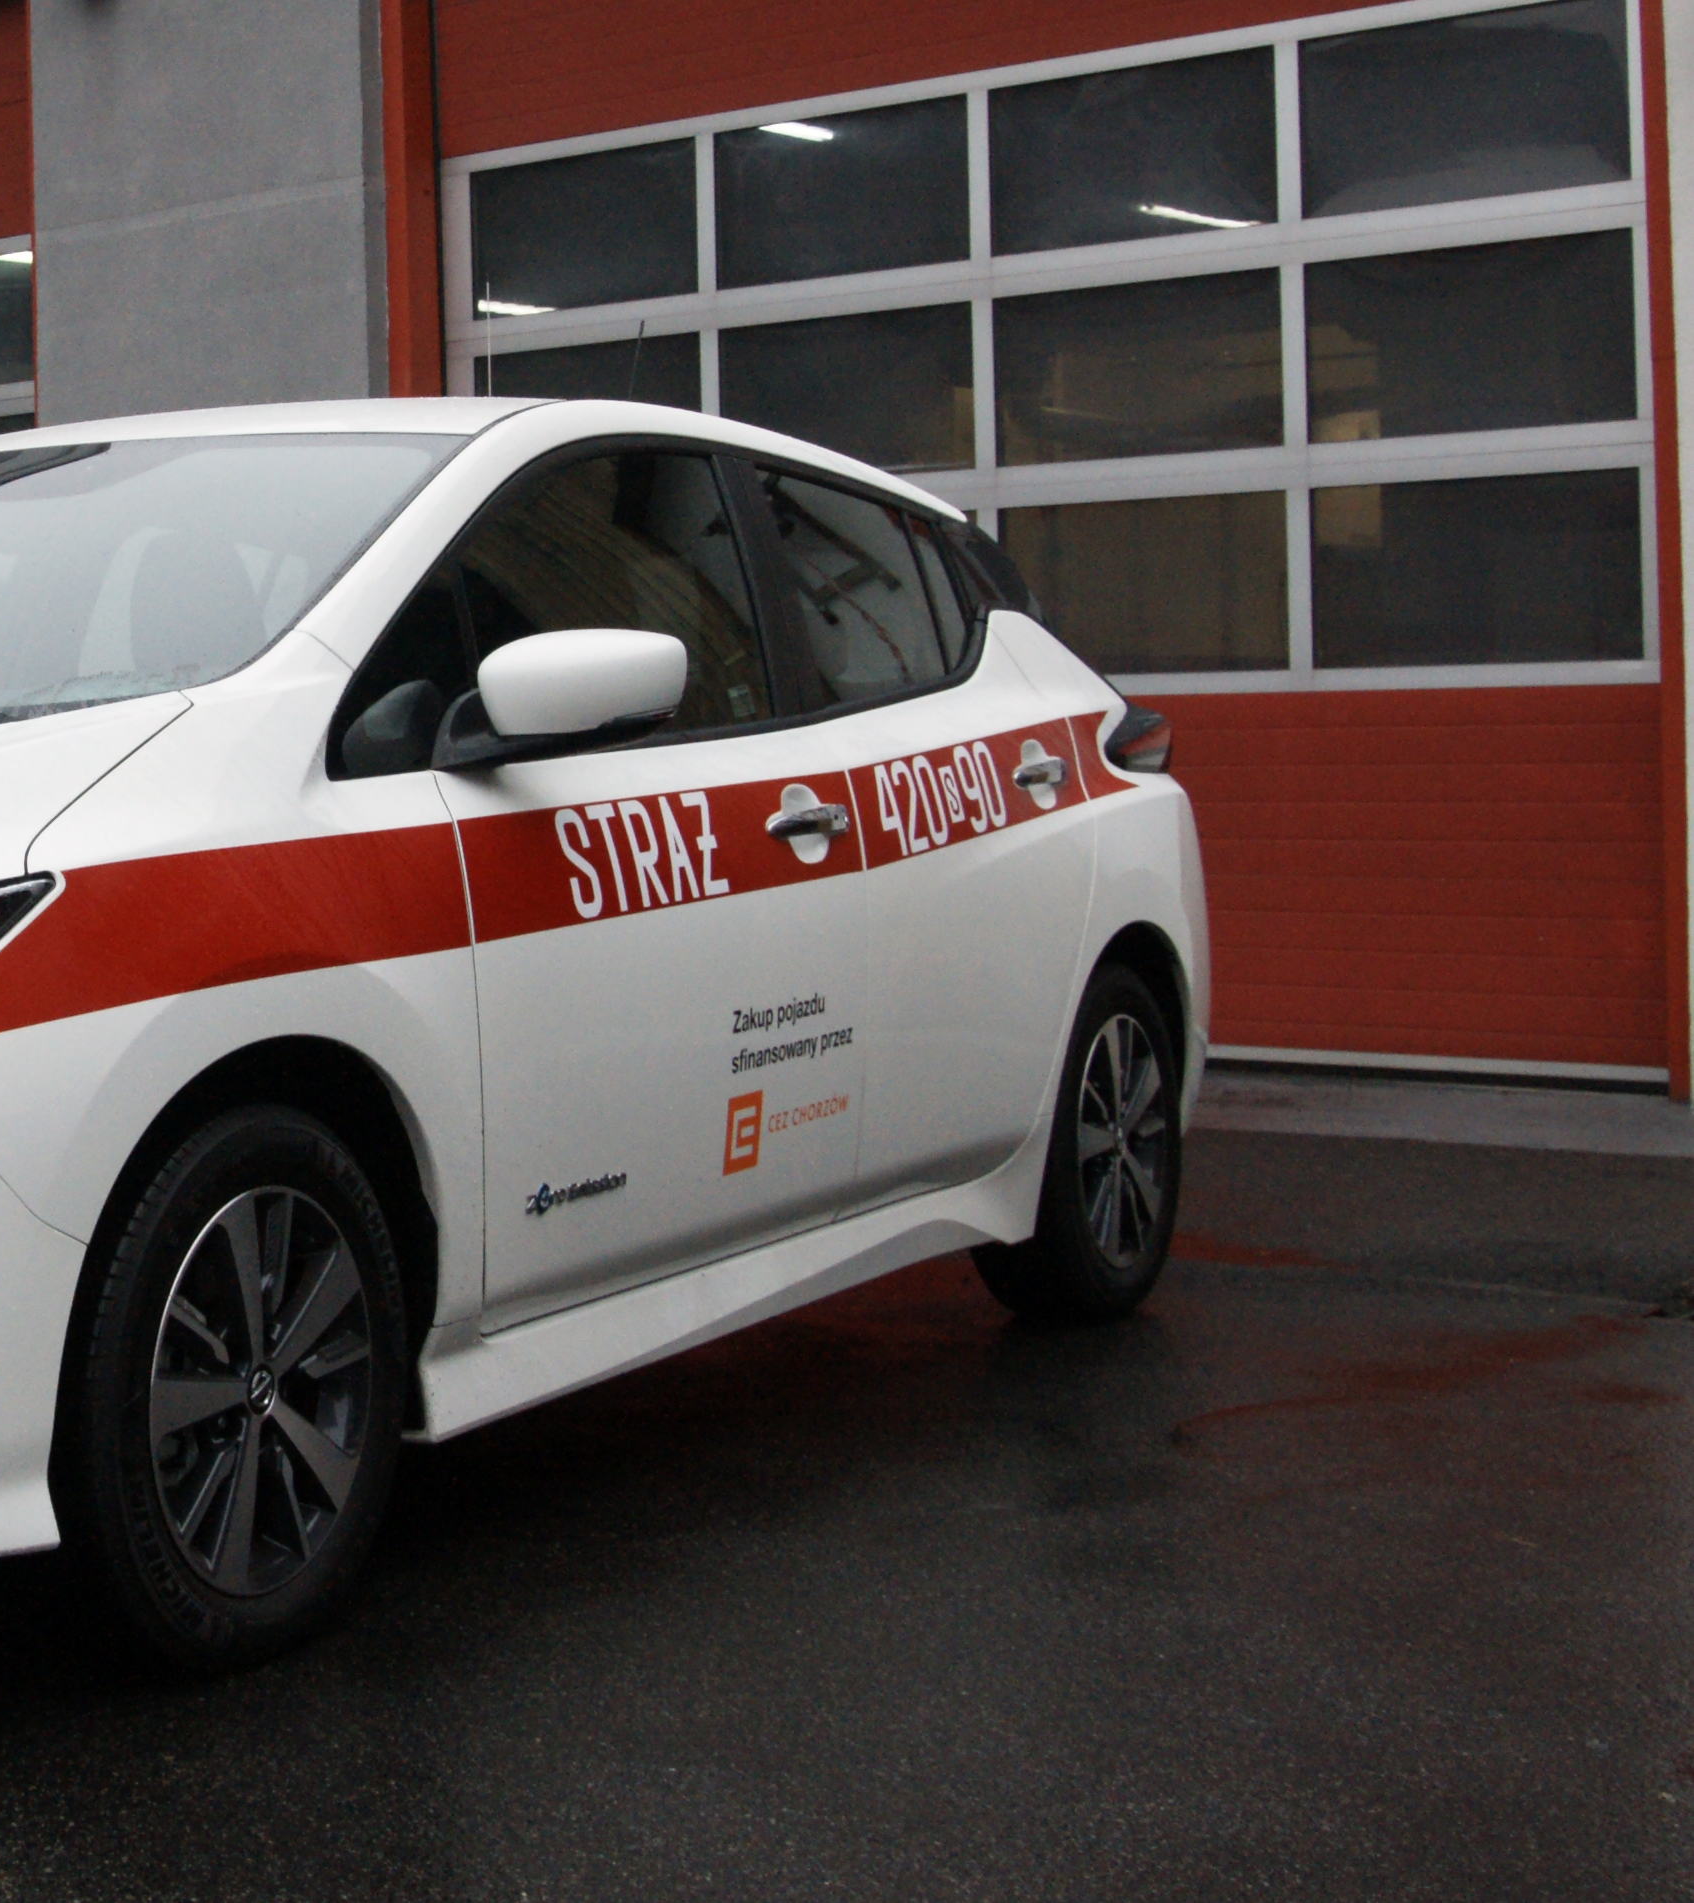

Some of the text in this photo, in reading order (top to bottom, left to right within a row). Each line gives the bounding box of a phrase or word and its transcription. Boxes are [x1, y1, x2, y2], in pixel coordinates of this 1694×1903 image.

[733, 993, 826, 1034] Zakup pojazdu
[731, 1026, 853, 1074] sfinansowany przez
[767, 1092, 850, 1133] CEZ CHORZÓW
